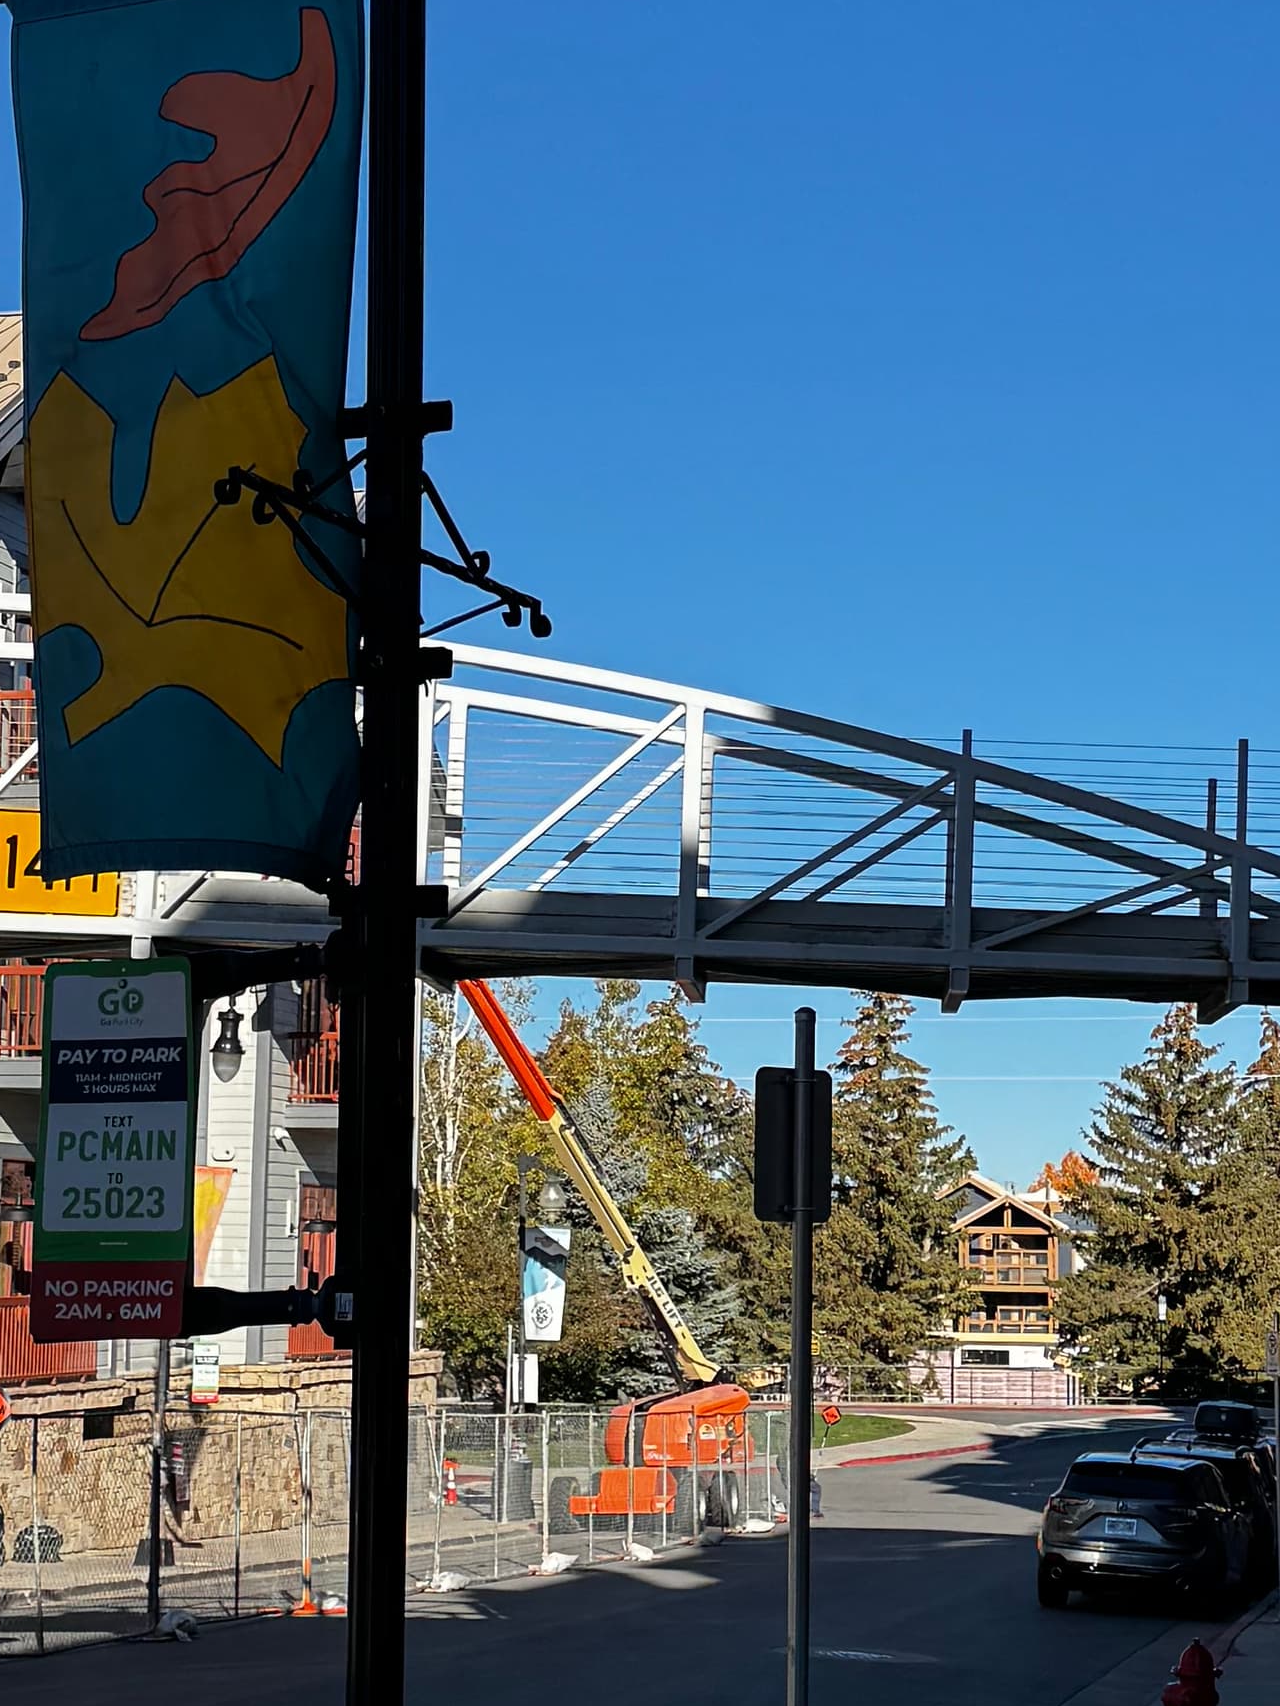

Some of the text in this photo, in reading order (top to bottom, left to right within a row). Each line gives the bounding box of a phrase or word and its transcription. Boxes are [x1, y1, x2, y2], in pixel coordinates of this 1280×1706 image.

[57, 1047, 182, 1064] PAY TO PARK
[75, 1073, 101, 1083] 11AM
[109, 1072, 163, 1082] MIDNIGHT
[83, 1083, 157, 1094] 3 HOURS MAX
[103, 1115, 134, 1128] TEXT
[57, 1129, 177, 1162] PCMAIN
[107, 1172, 124, 1185] TO
[61, 1186, 166, 1220] 25023
[44, 1279, 174, 1297] NO PARKING
[55, 1303, 102, 1320] 2AM
[119, 1303, 162, 1320] 6AM
